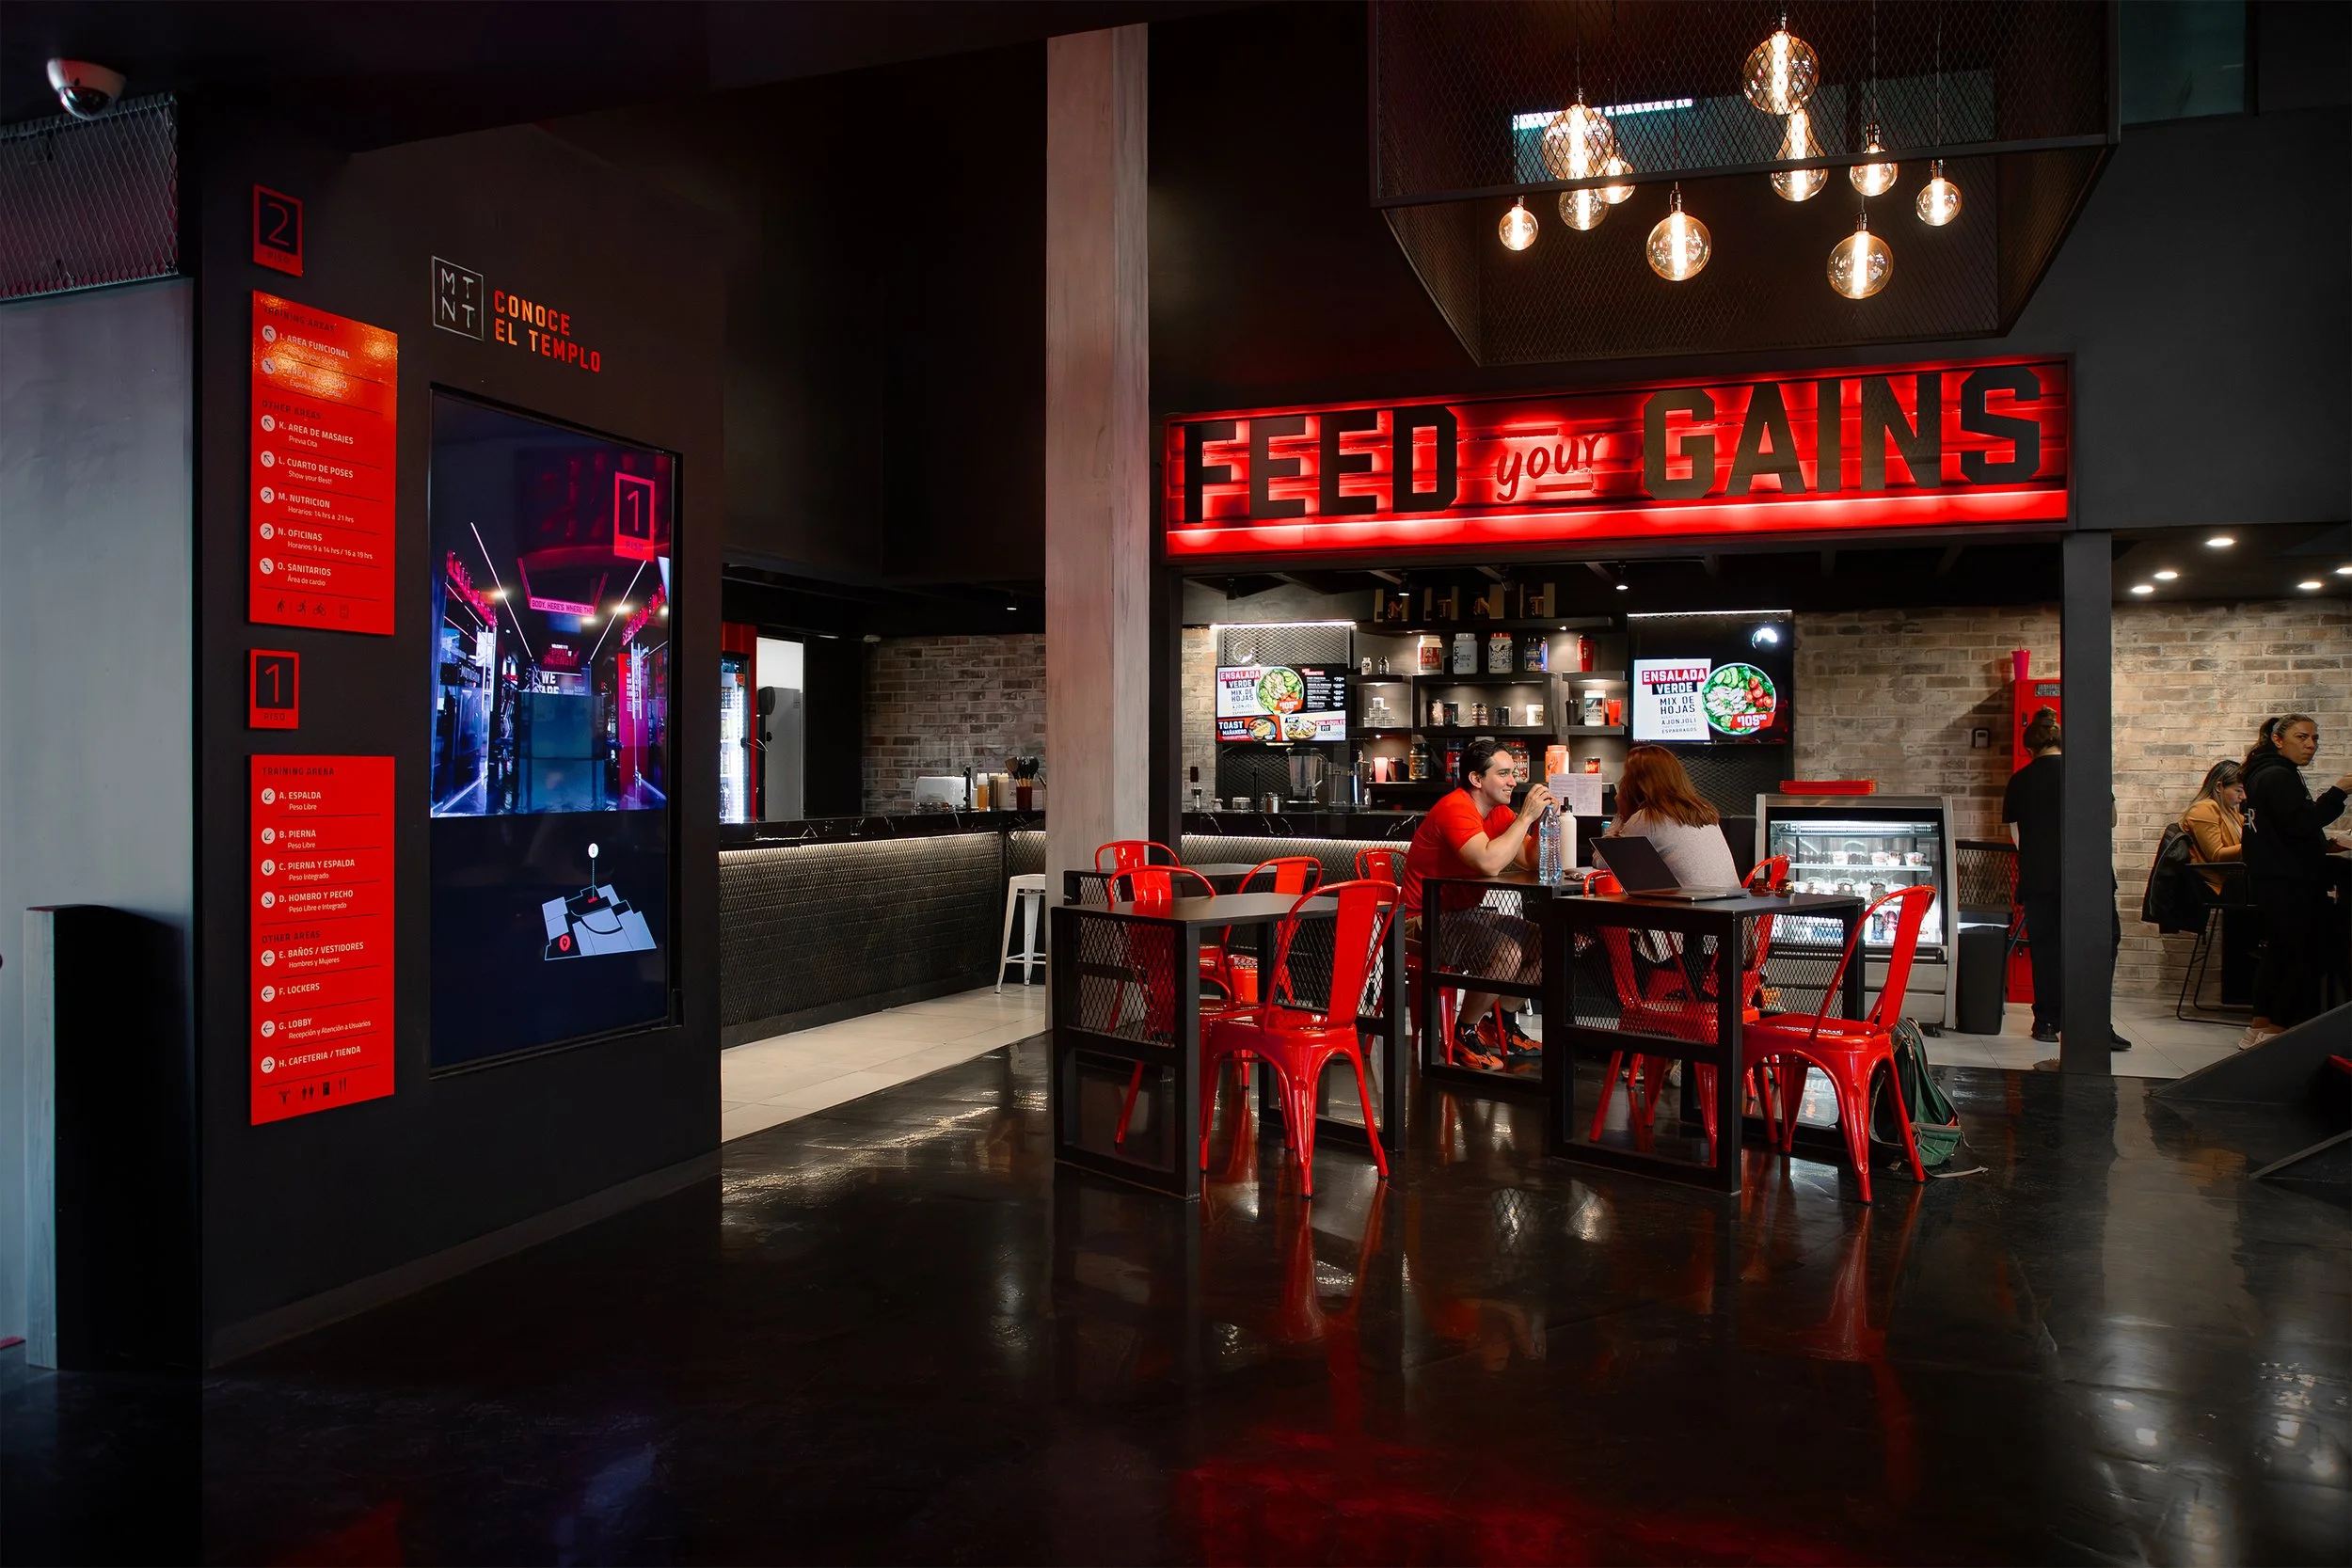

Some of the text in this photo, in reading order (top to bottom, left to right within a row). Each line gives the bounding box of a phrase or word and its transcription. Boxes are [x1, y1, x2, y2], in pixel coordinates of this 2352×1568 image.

[267, 202, 290, 246] 2
[264, 306, 305, 325] TRAINING
[494, 290, 571, 336] CONOCE
[287, 335, 307, 346] AREA
[309, 341, 350, 358] FUNCIONAL
[495, 318, 601, 373] EL TEMPLO
[262, 400, 322, 420] OTHER AREAS
[278, 421, 354, 445] K. AREA DE MASAJES
[289, 435, 318, 448] Previa Cita
[1184, 367, 2041, 524] FEED your GAINS
[278, 456, 354, 479] L. CUARTO DE POSES
[288, 470, 304, 480] Show
[278, 492, 330, 509] M. NUTRICION
[288, 506, 313, 516] Horarios:
[322, 511, 331, 519] hrs
[344, 515, 355, 523] hrs
[628, 490, 639, 531] 1
[278, 527, 323, 542] N. OFICINAS
[288, 541, 313, 551] Horarios:
[626, 541, 644, 552] PISO
[278, 562, 331, 577] O. SANITARIOS
[309, 578, 326, 586] cardio
[565, 605, 582, 613] WHERE
[541, 672, 556, 684] WE
[1220, 670, 1260, 680] ENSALADA
[1643, 669, 1706, 682] ENSALADA
[265, 663, 279, 703] 1
[1656, 682, 1693, 694] VERDE
[1660, 697, 1677, 705] MIX
[1661, 705, 1695, 715] HOJAS
[1218, 721, 1243, 729] TOAST
[278, 791, 322, 800] A. ESPALDA
[288, 830, 316, 838] PIERNA
[278, 863, 286, 871] C.
[288, 861, 315, 870] PIERNA
[324, 859, 355, 868] ESPALDA
[289, 892, 322, 902] HOMBRO
[329, 890, 354, 898] PECHO
[322, 902, 347, 911] Integrado
[262, 930, 321, 943] OTHER AREAS
[288, 947, 313, 958] BAÑOS
[321, 942, 364, 954] VESTIDORES
[289, 959, 314, 969] Hombres
[319, 957, 341, 965] Mujeres
[288, 983, 320, 994] LOCKERS
[288, 1018, 312, 1029] LOBBY
[289, 1028, 316, 1039] Recepción
[321, 1024, 344, 1035] Atención
[349, 1020, 371, 1030] Usuarios
[289, 1052, 328, 1066] CAFETERIA
[335, 1045, 361, 1057] TIENDA
